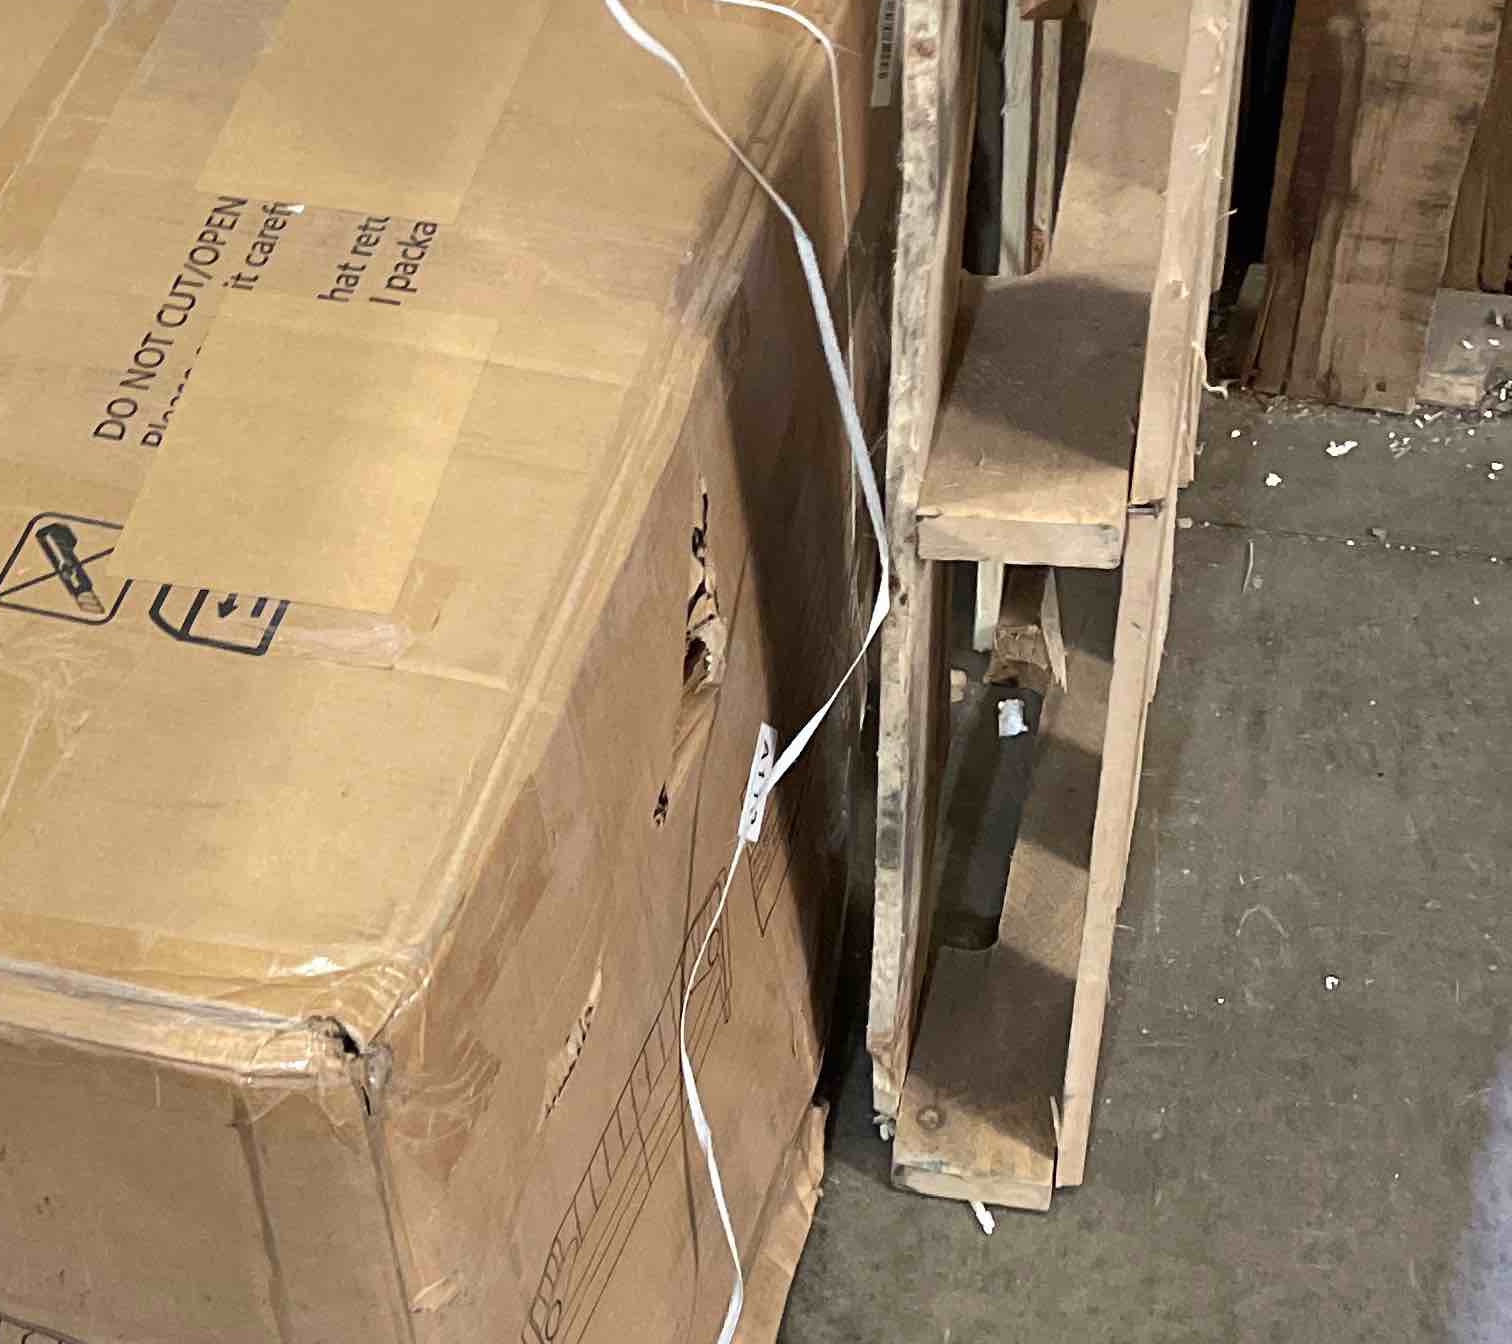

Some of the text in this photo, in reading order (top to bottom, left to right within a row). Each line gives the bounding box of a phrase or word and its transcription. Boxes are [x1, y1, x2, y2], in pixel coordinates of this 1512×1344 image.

[93, 397, 138, 441] DO
[119, 331, 174, 391] NOT
[156, 195, 248, 328] CUT/OPEN
